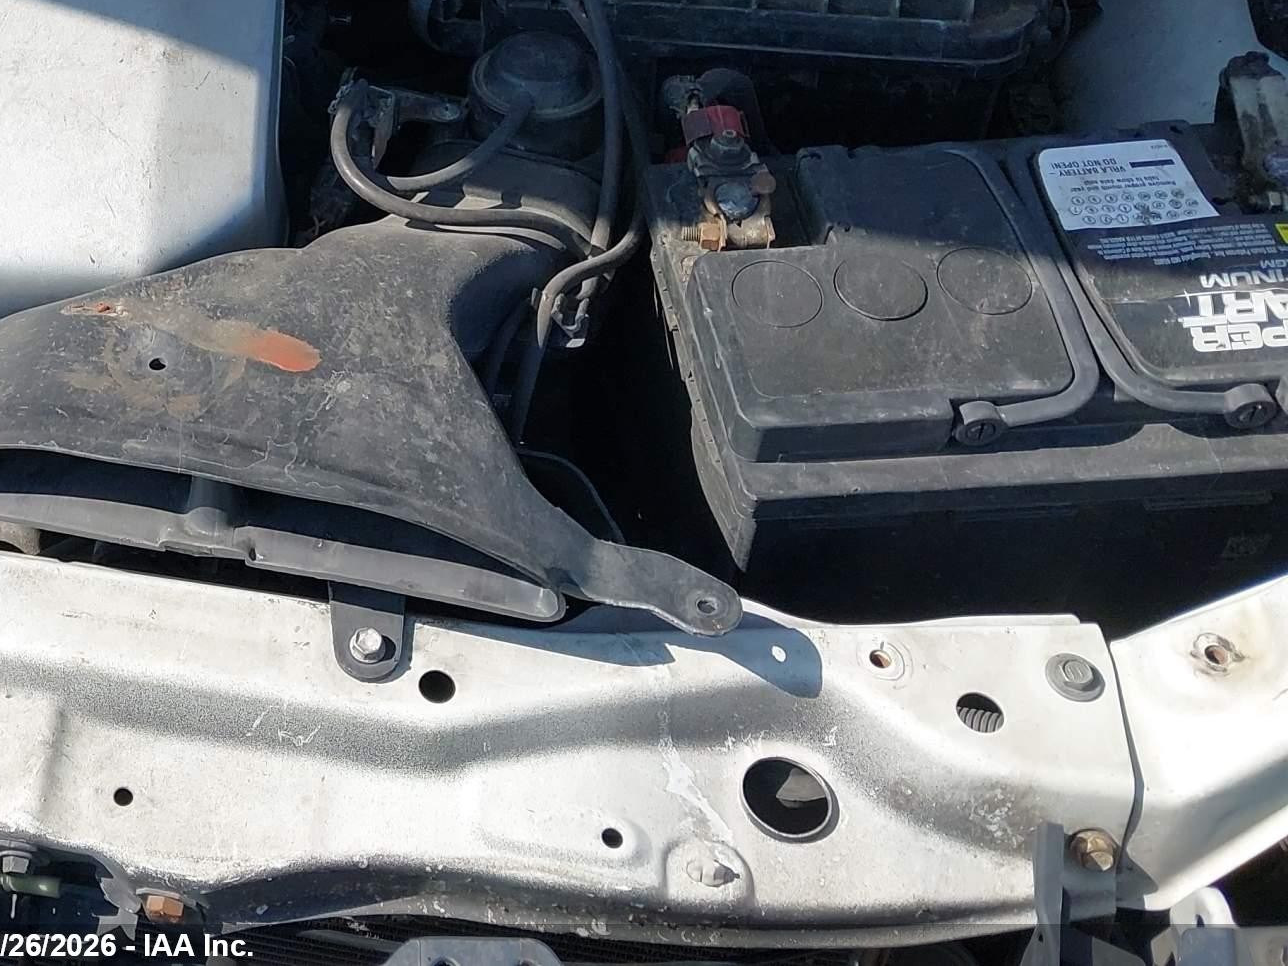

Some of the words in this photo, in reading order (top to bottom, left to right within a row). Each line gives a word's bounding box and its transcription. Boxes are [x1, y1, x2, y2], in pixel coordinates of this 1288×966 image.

[1051, 161, 1080, 170] OPEN!
[1081, 159, 1101, 168] NOT
[1103, 158, 1118, 166] DO
[1058, 167, 1100, 177] BATTERY
[1199, 270, 1288, 288] INUM
